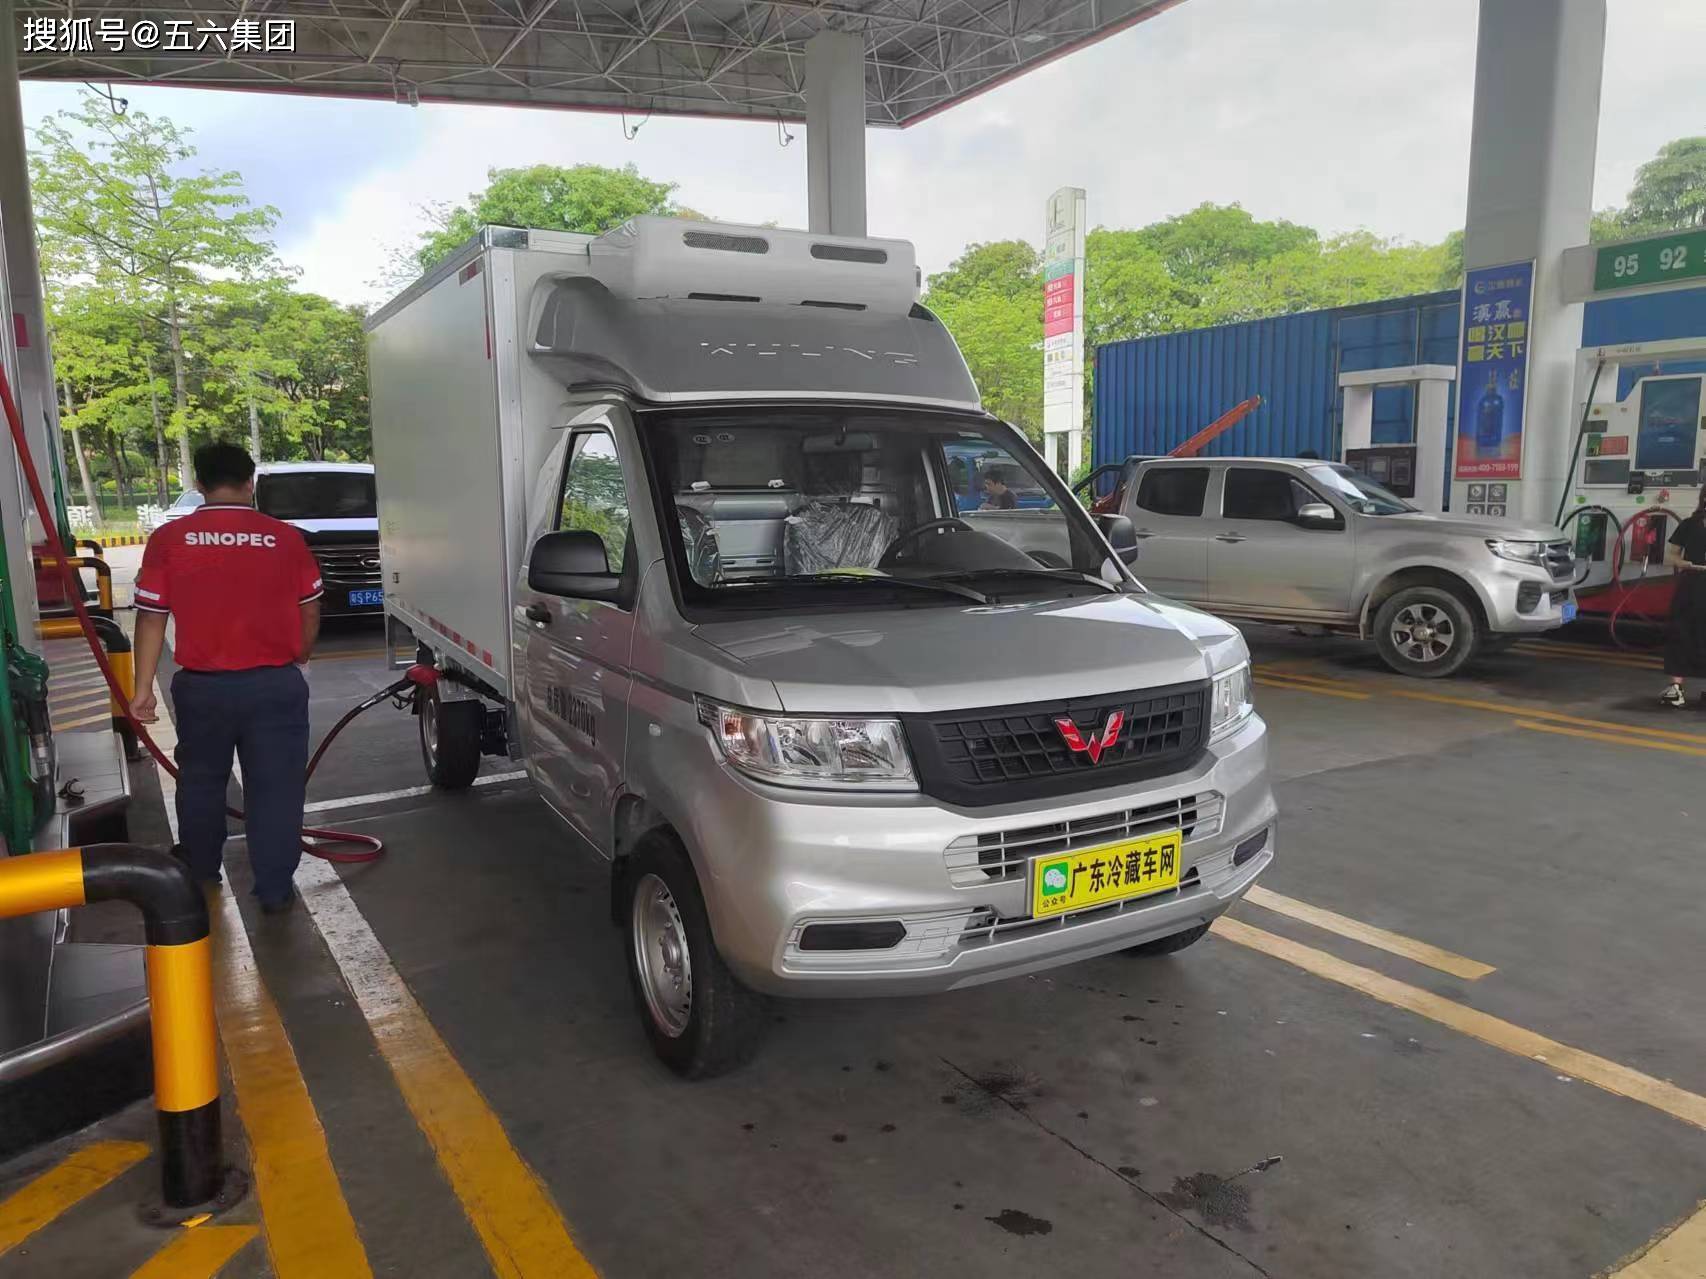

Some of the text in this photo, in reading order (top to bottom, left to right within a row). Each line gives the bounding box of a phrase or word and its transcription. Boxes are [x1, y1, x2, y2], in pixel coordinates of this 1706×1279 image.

[1614, 254, 1639, 277] 95
[1660, 246, 1687, 270] 92
[185, 532, 276, 547] SINOPEC
[1070, 844, 1175, 898] 广东冷藏车网
[1042, 896, 1067, 909] 公众号
